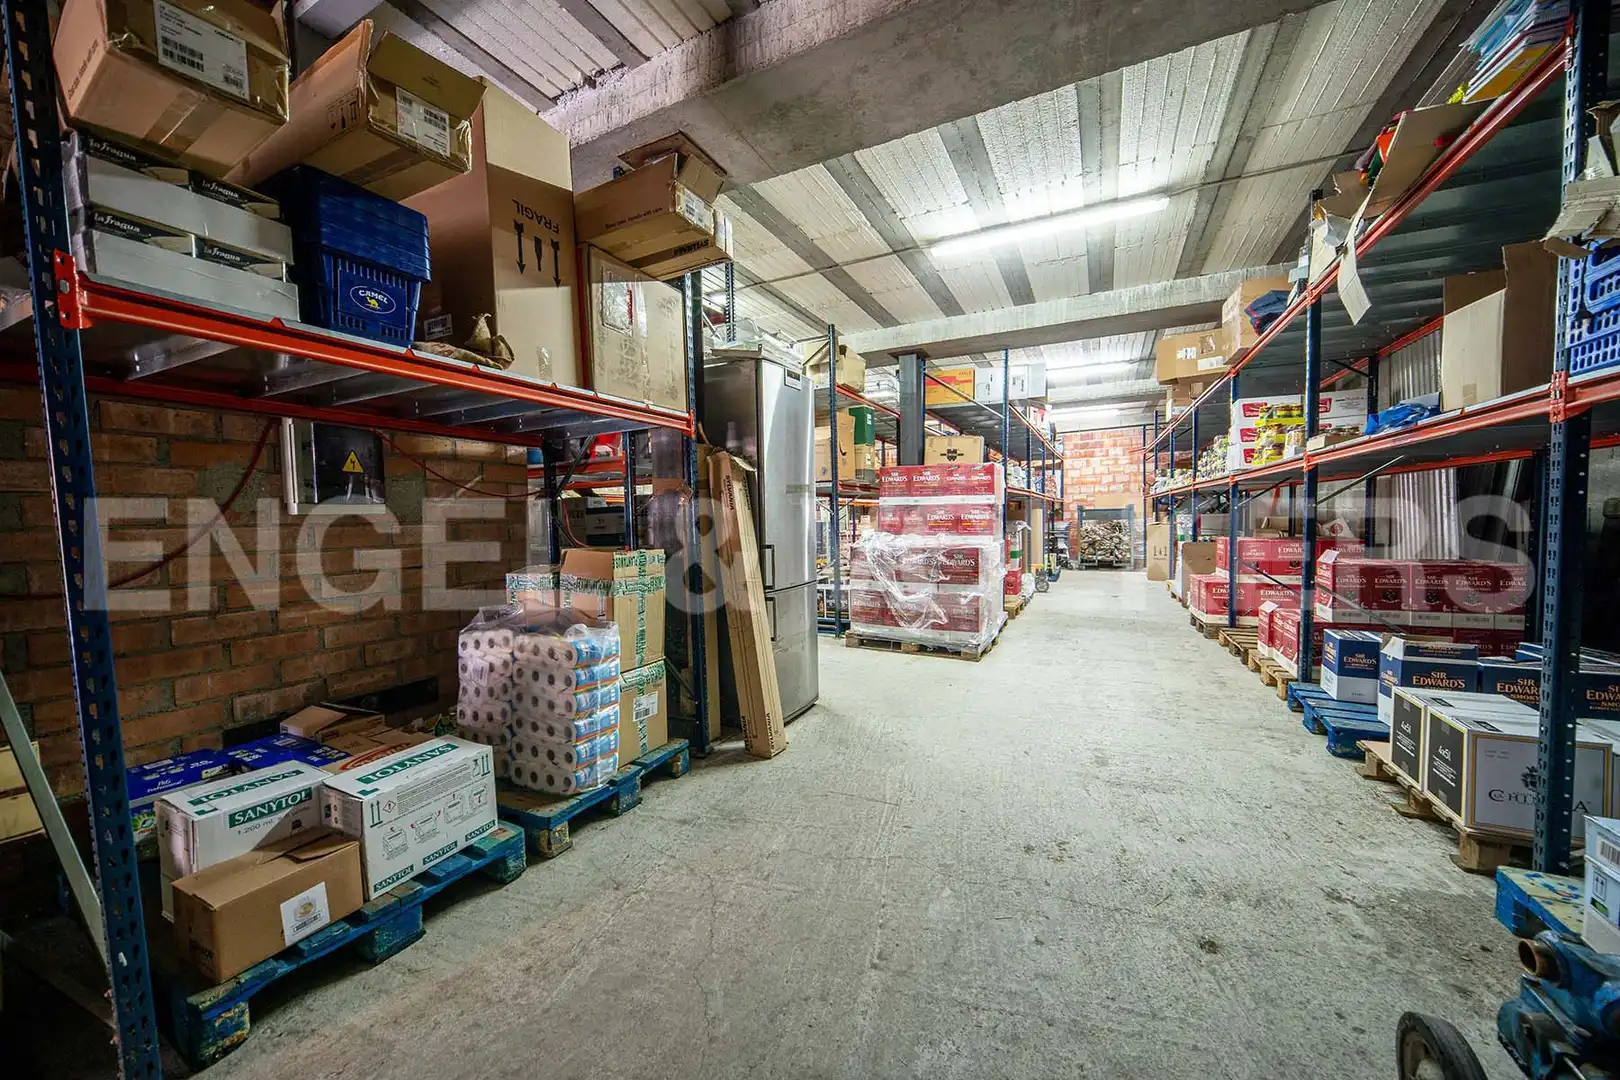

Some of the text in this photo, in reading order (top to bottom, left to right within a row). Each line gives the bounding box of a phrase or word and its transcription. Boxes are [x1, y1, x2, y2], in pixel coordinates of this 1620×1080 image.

[512, 200, 560, 234] FRAGIL
[358, 288, 389, 305] CAMEL
[726, 474, 734, 511] SYLVANIA
[1412, 676, 1466, 689] EDWARD'S
[1431, 671, 1447, 679] SIR
[1517, 678, 1535, 686] SIR
[1496, 682, 1540, 694] EDWAR
[363, 744, 453, 784] SANYTOL
[234, 791, 309, 825] SANYTOL
[466, 820, 496, 842] SANYTOL
[424, 843, 458, 864] SANYTOL
[374, 866, 413, 892] SANYTOL
